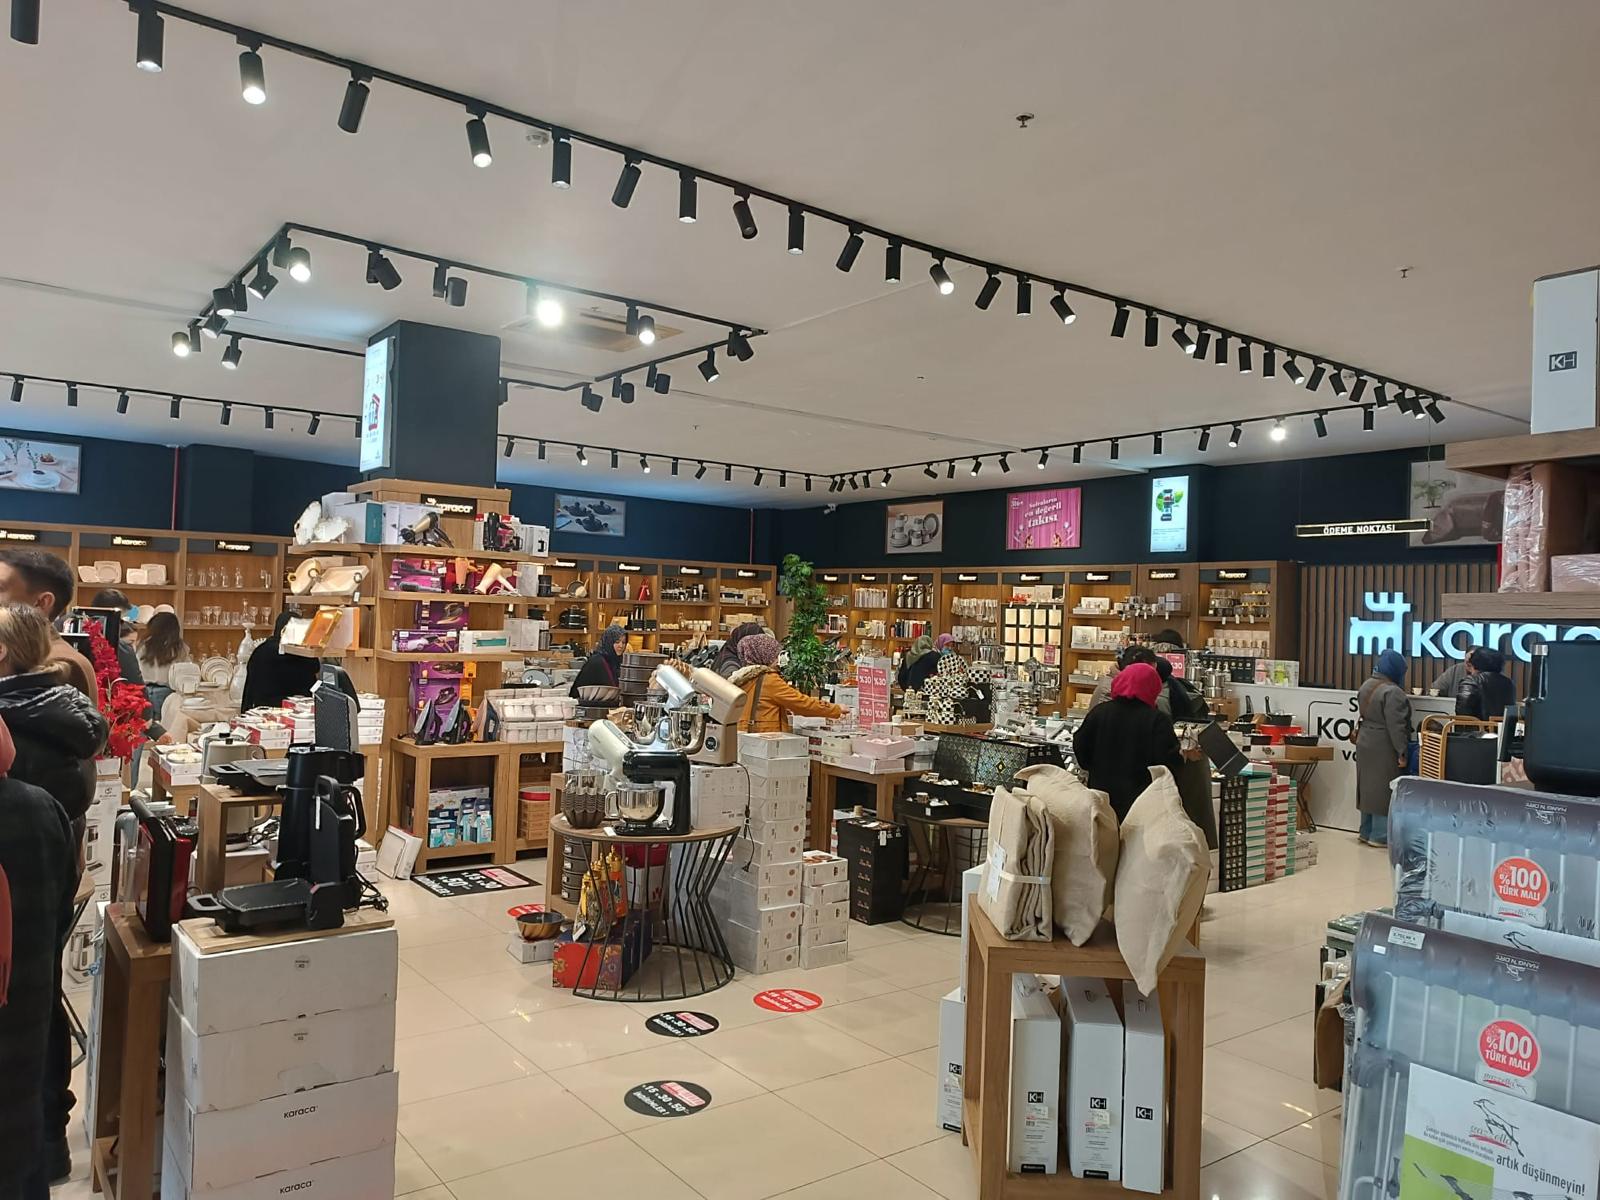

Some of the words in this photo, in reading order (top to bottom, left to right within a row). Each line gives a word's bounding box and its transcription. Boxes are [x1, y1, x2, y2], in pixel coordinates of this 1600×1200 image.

[1551, 353, 1575, 370] KH
[1323, 525, 1353, 535] ÖDEME
[1356, 524, 1396, 534] NOKTASI
[1349, 697, 1359, 712] S
[1500, 866, 1542, 892] %100
[1499, 885, 1520, 898] TÜRK
[1520, 889, 1541, 902] MALI
[1486, 1028, 1532, 1060] %100
[1485, 1049, 1507, 1066] TÜRK
[1508, 1057, 1531, 1072] MALI
[949, 1063, 962, 1075] KH
[1028, 1092, 1044, 1103] KH
[1090, 1097, 1107, 1109] KH
[283, 1105, 317, 1119] karaca
[1136, 1107, 1153, 1120] KH
[1496, 1153, 1519, 1171] artık
[1522, 1161, 1586, 1197] düşünmeyin!
[279, 1179, 313, 1194] karaca
